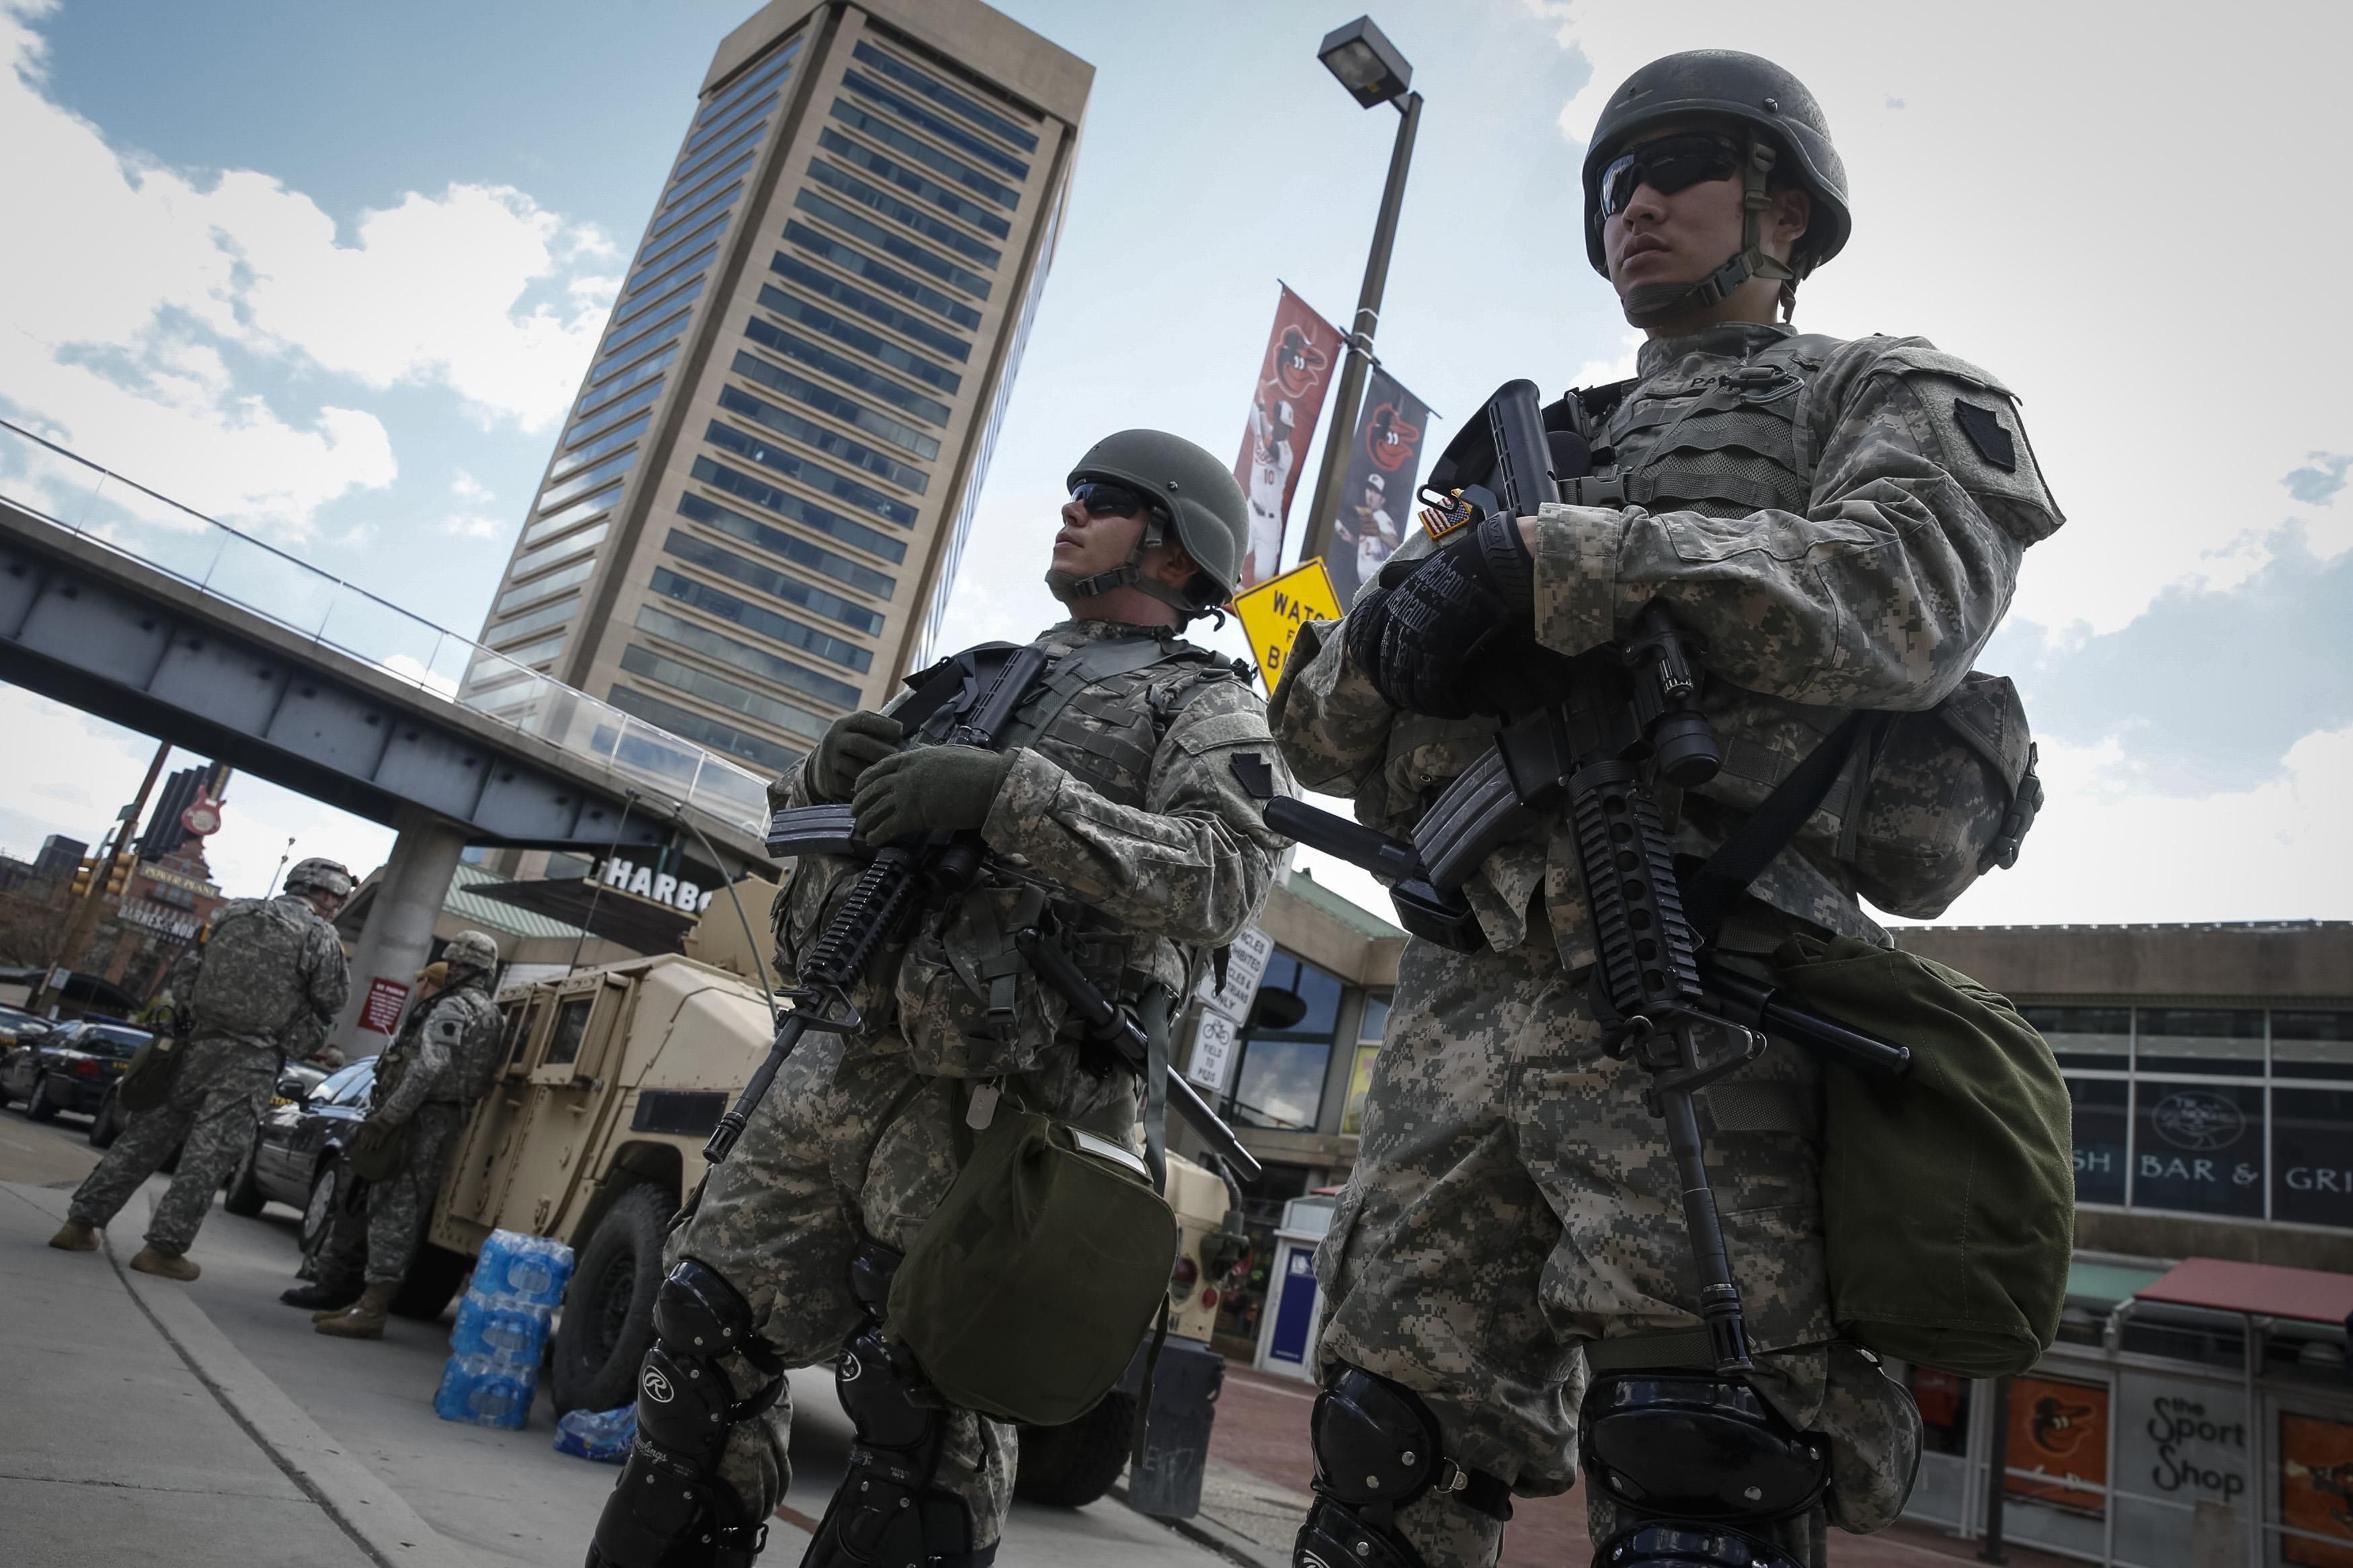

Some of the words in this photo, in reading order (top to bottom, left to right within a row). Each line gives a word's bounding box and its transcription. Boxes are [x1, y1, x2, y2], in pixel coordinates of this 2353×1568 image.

[1264, 468, 1275, 485] 10
[1273, 589, 1332, 624] WAT
[145, 866, 182, 885] POWER
[184, 878, 217, 898] PLANT
[1203, 1043, 1222, 1057] YIELD
[2140, 1154, 2217, 1183] BAR
[2231, 1163, 2259, 1186] &
[2285, 1167, 2352, 1194] GRI
[2147, 1396, 2246, 1448] Sport
[2172, 1397, 2205, 1416] the
[2153, 1444, 2244, 1503] Shop
